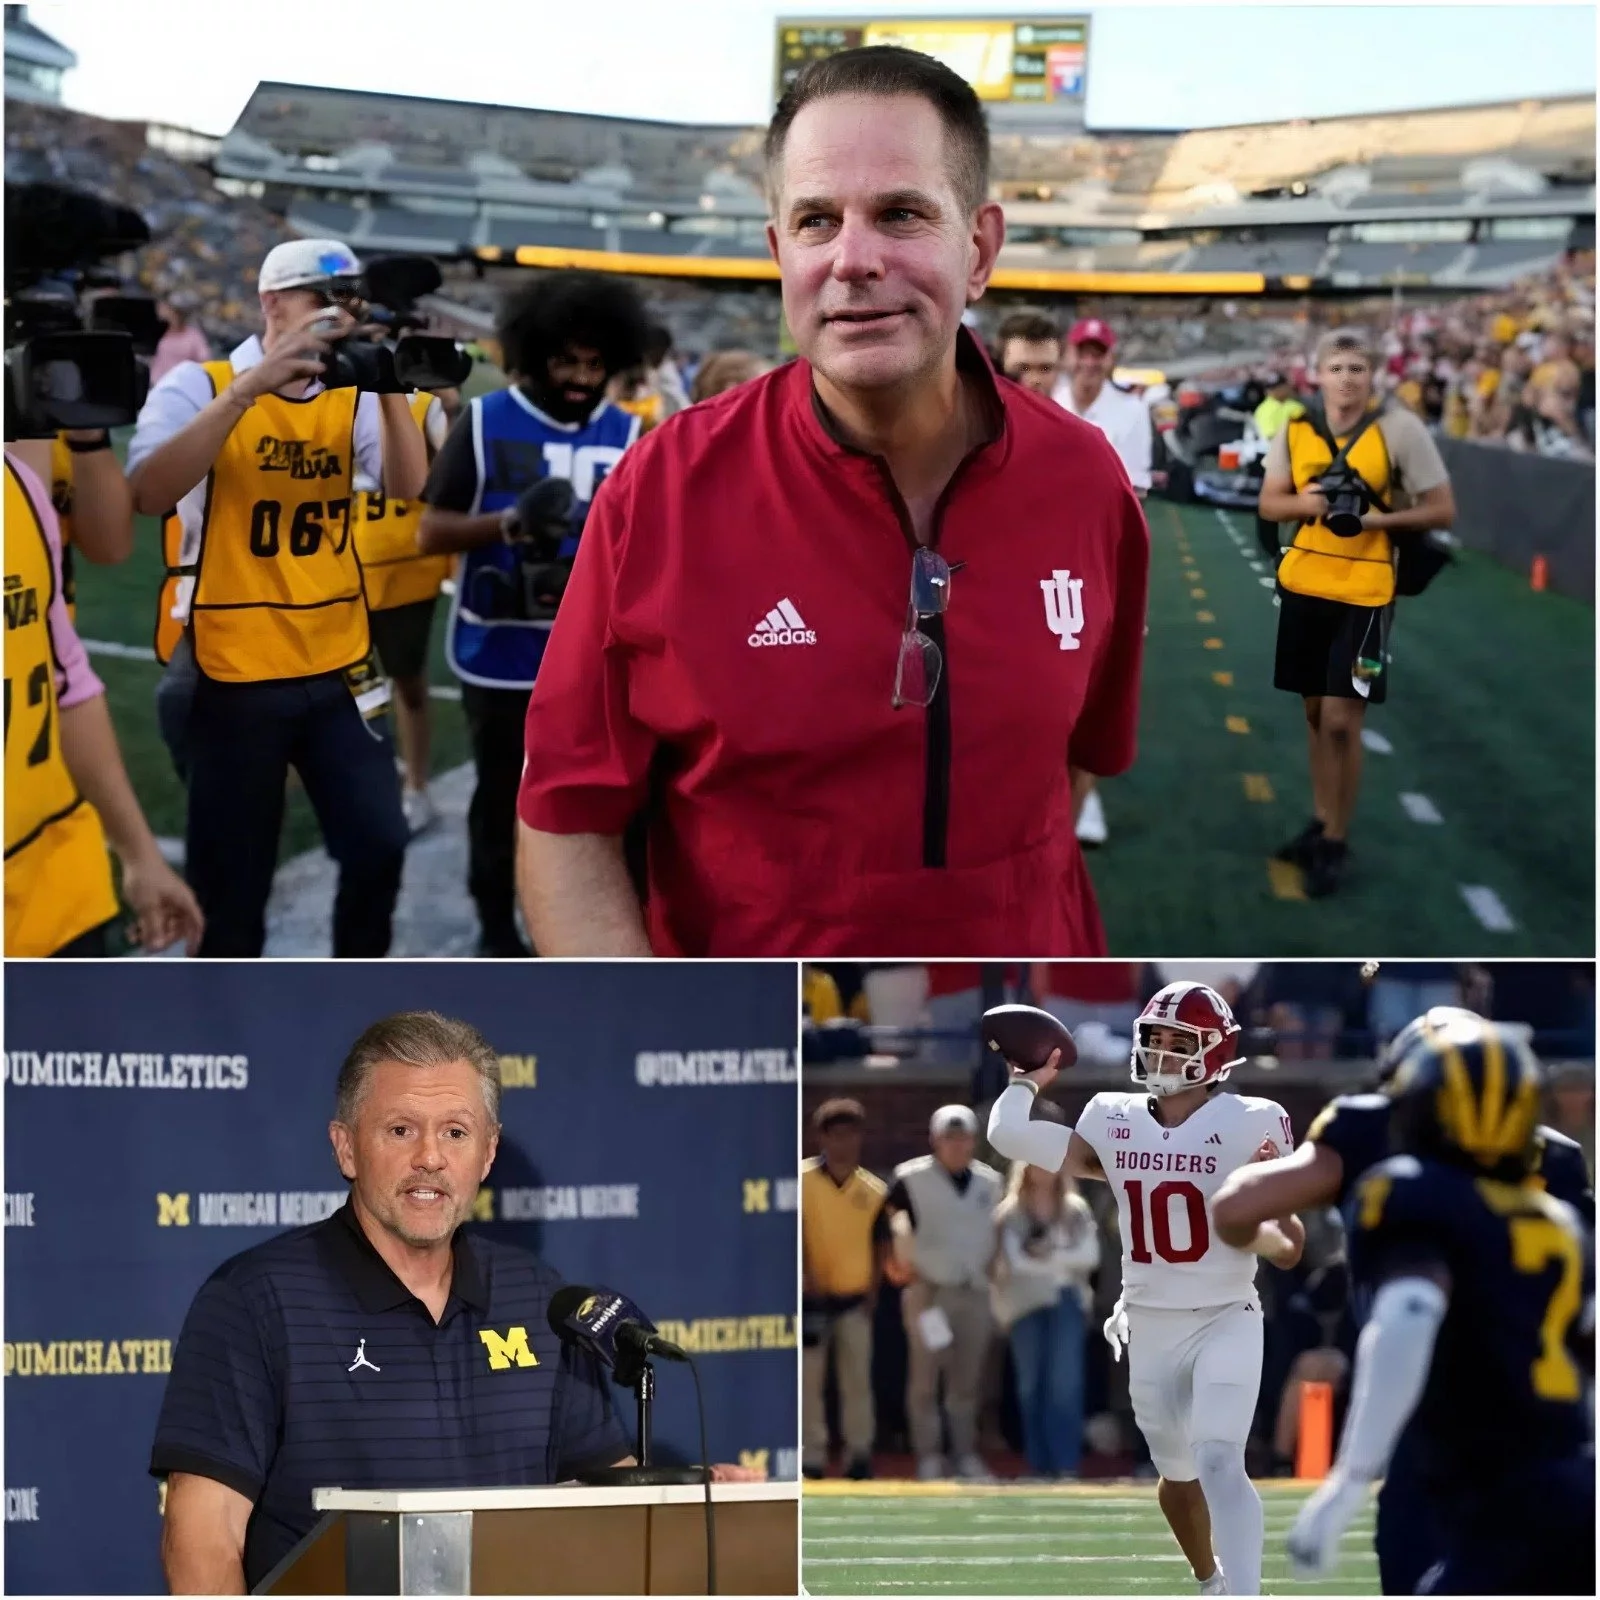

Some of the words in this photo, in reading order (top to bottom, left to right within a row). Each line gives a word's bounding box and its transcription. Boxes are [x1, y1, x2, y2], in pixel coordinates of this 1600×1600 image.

[250, 499, 350, 558] 067
[747, 628, 817, 648] adidas
[635, 1048, 798, 1087] @UMICHATHL
[1115, 1150, 1218, 1175] HOOSIERS
[156, 1192, 191, 1227] M
[1123, 1179, 1210, 1265] 10
[1508, 1217, 1583, 1400] 7
[478, 1326, 540, 1370] M
